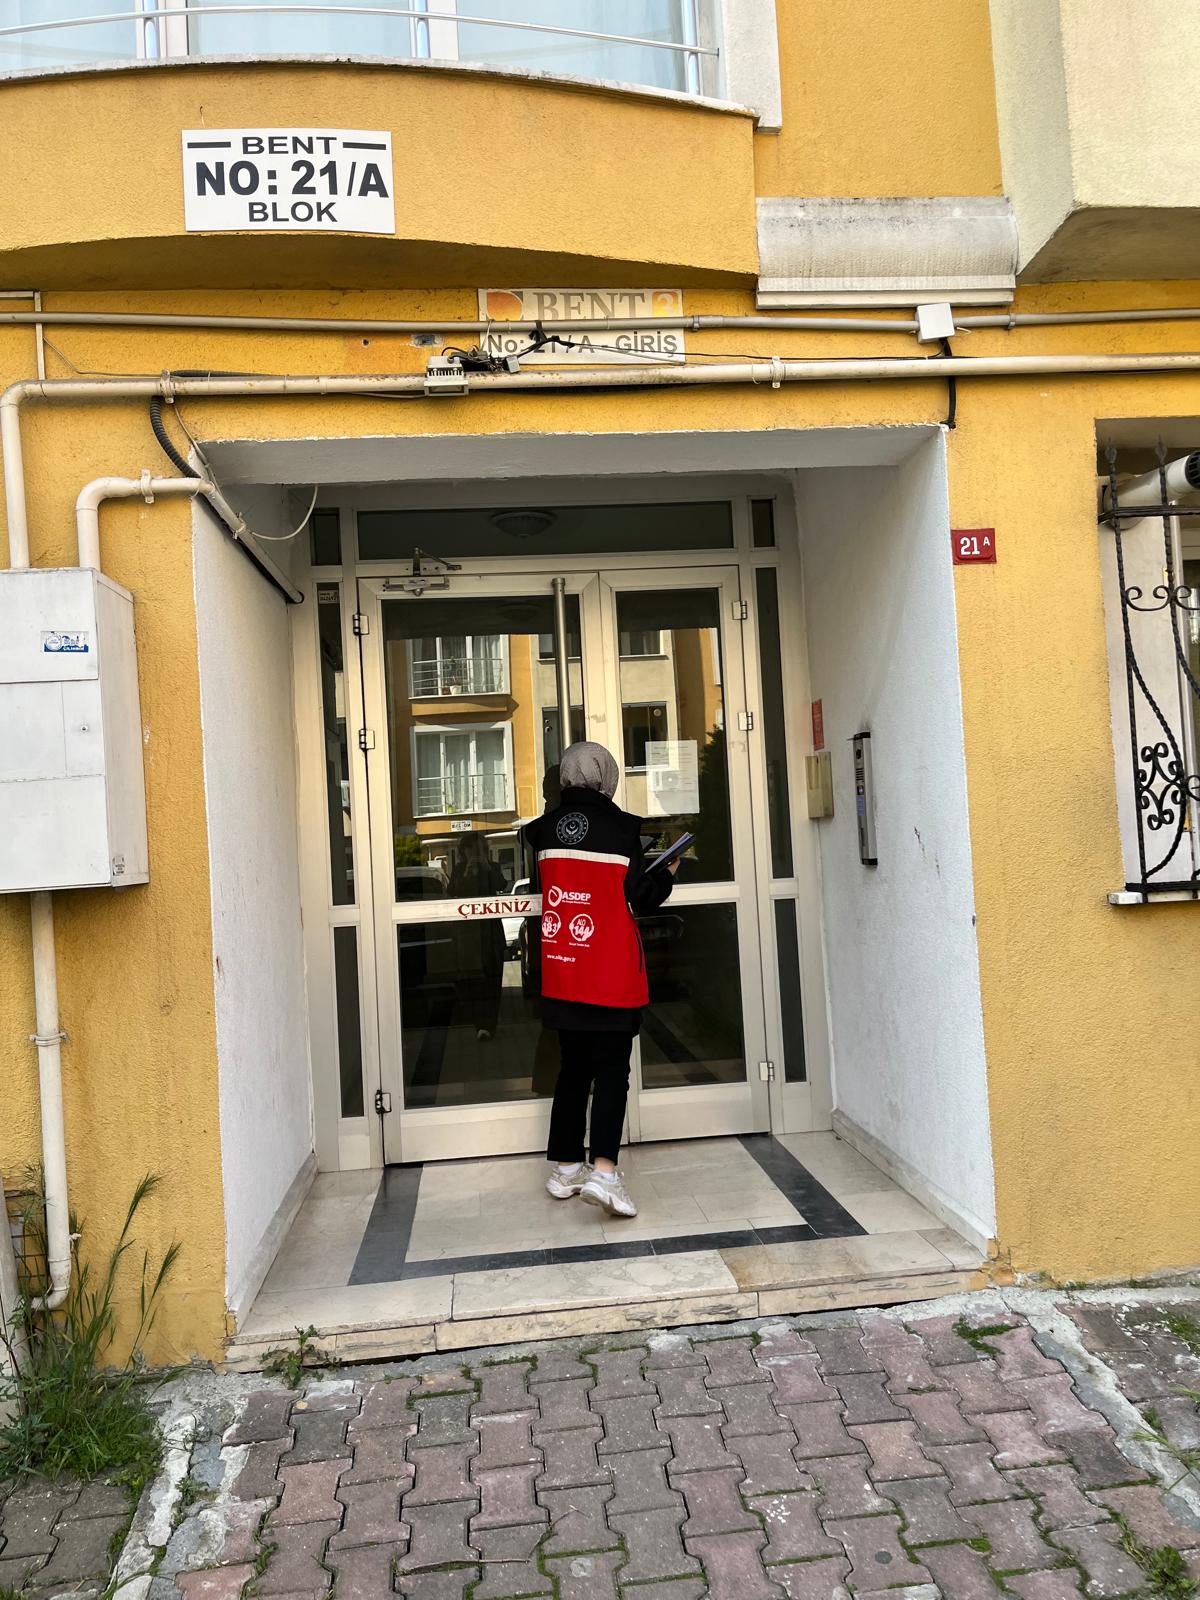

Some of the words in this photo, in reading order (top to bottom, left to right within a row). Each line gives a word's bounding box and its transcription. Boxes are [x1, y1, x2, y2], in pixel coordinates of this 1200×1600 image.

[242, 136, 338, 155] BENT
[196, 160, 278, 196] NO:
[291, 160, 390, 198] 21/A
[248, 201, 338, 223] BLOK
[532, 291, 646, 320] BENT
[487, 334, 525, 353] No:
[615, 330, 678, 358] GİRİŞ
[959, 536, 980, 555] 21
[983, 536, 991, 546] A
[561, 891, 591, 901] ASDEP
[457, 899, 532, 918] ÇEKİNİZ
[543, 921, 558, 933] 183
